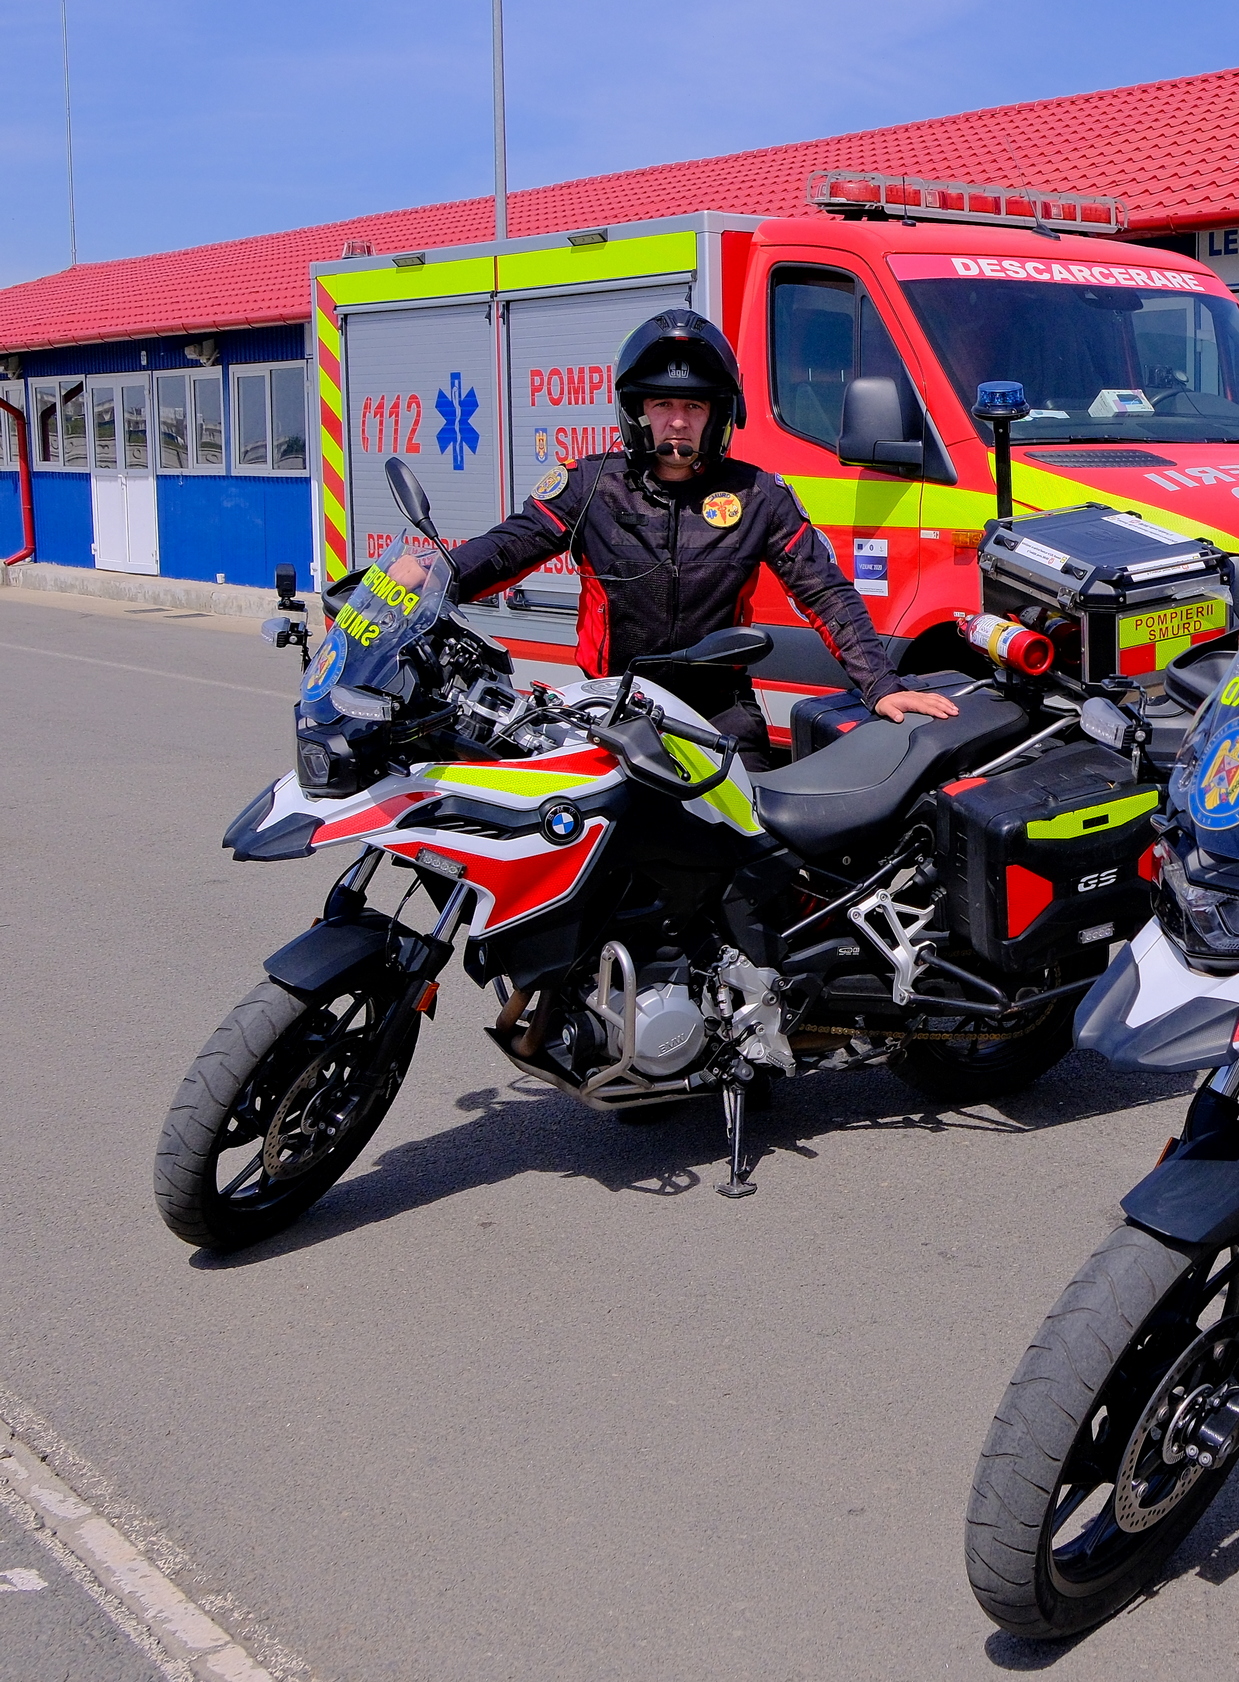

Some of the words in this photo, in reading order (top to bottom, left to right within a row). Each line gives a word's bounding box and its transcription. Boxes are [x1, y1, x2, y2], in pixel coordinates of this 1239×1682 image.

[950, 257, 1206, 292] DESCARCERARE
[529, 364, 614, 407] POMPI
[1134, 603, 1215, 632] POMPIERII
[1148, 619, 1203, 641] SMURD
[1077, 867, 1119, 893] GS
